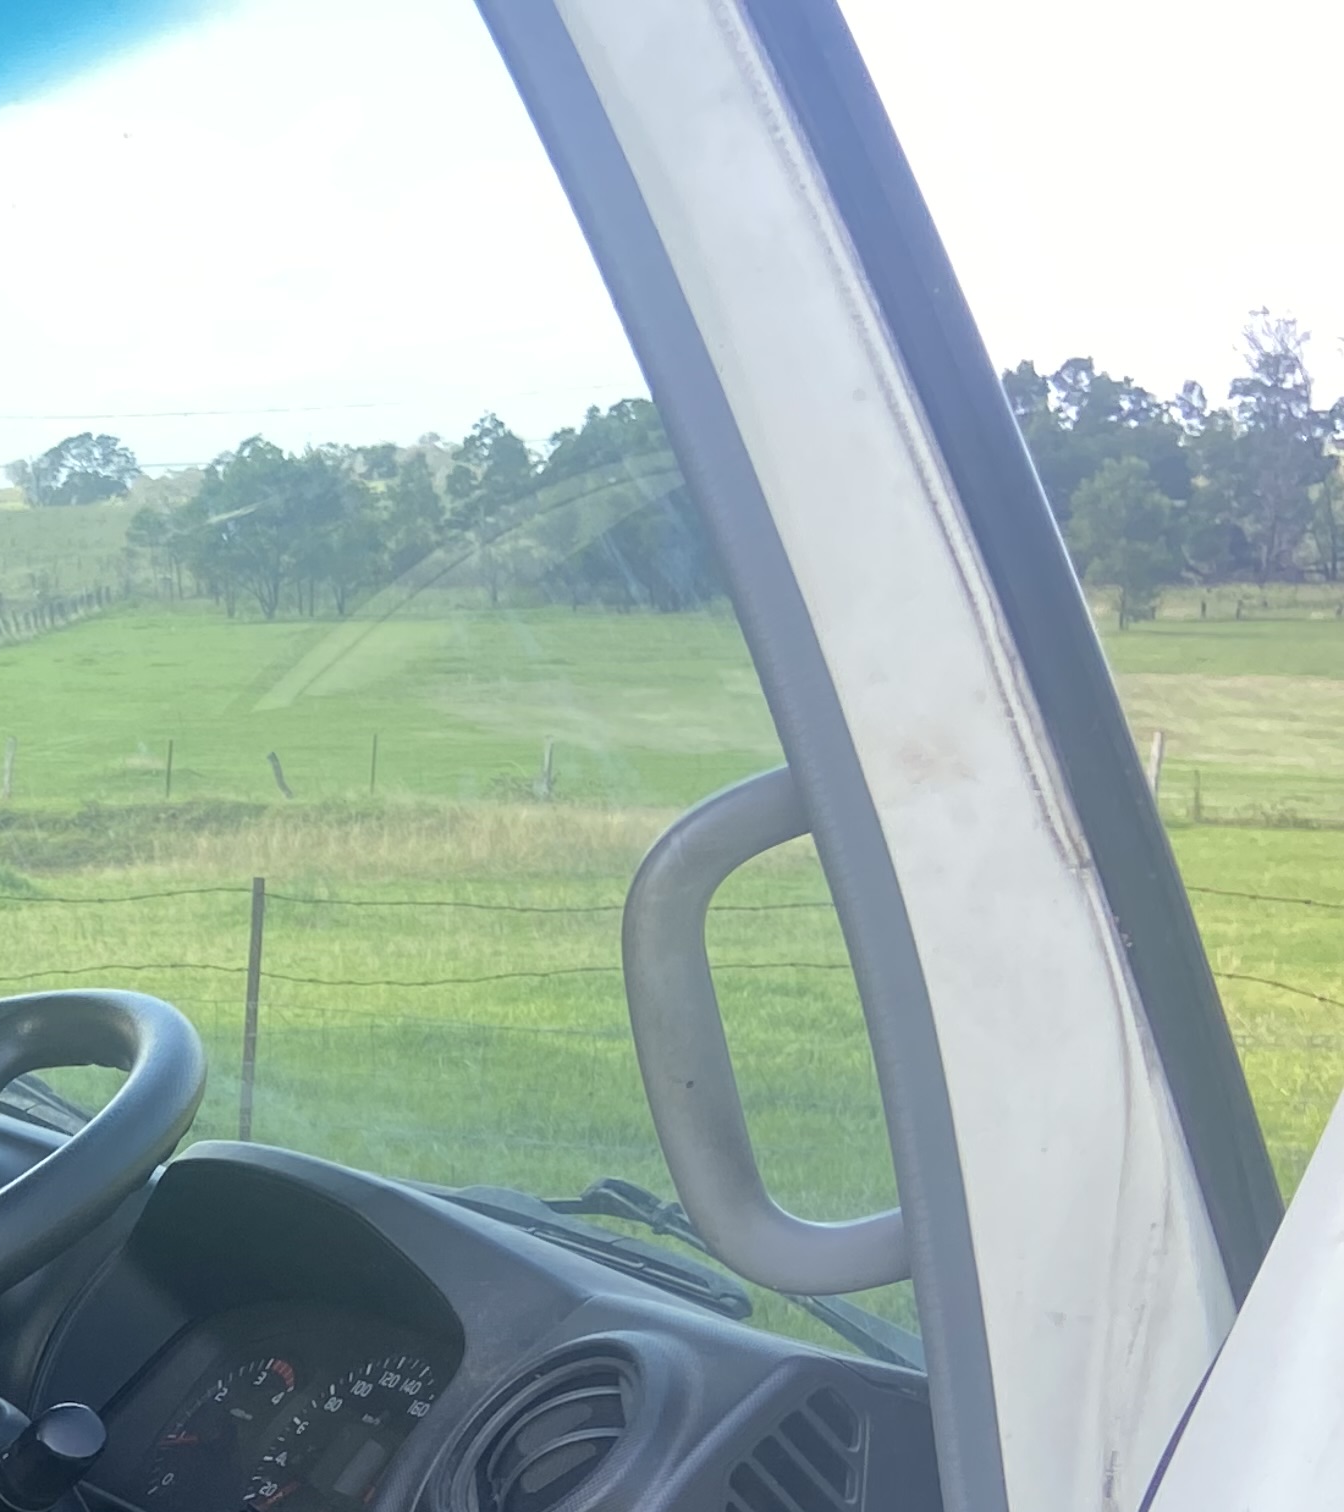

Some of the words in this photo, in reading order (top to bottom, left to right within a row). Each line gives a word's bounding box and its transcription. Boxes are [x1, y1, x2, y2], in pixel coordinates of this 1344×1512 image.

[253, 1371, 267, 1385] 3
[378, 1371, 401, 1388] 120
[215, 1387, 228, 1401] 2
[350, 1380, 373, 1397] 100
[399, 1378, 422, 1395] 140
[271, 1391, 285, 1405] 4
[324, 1396, 343, 1412] 80
[407, 1400, 430, 1417] 160
[162, 1472, 174, 1486] 0
